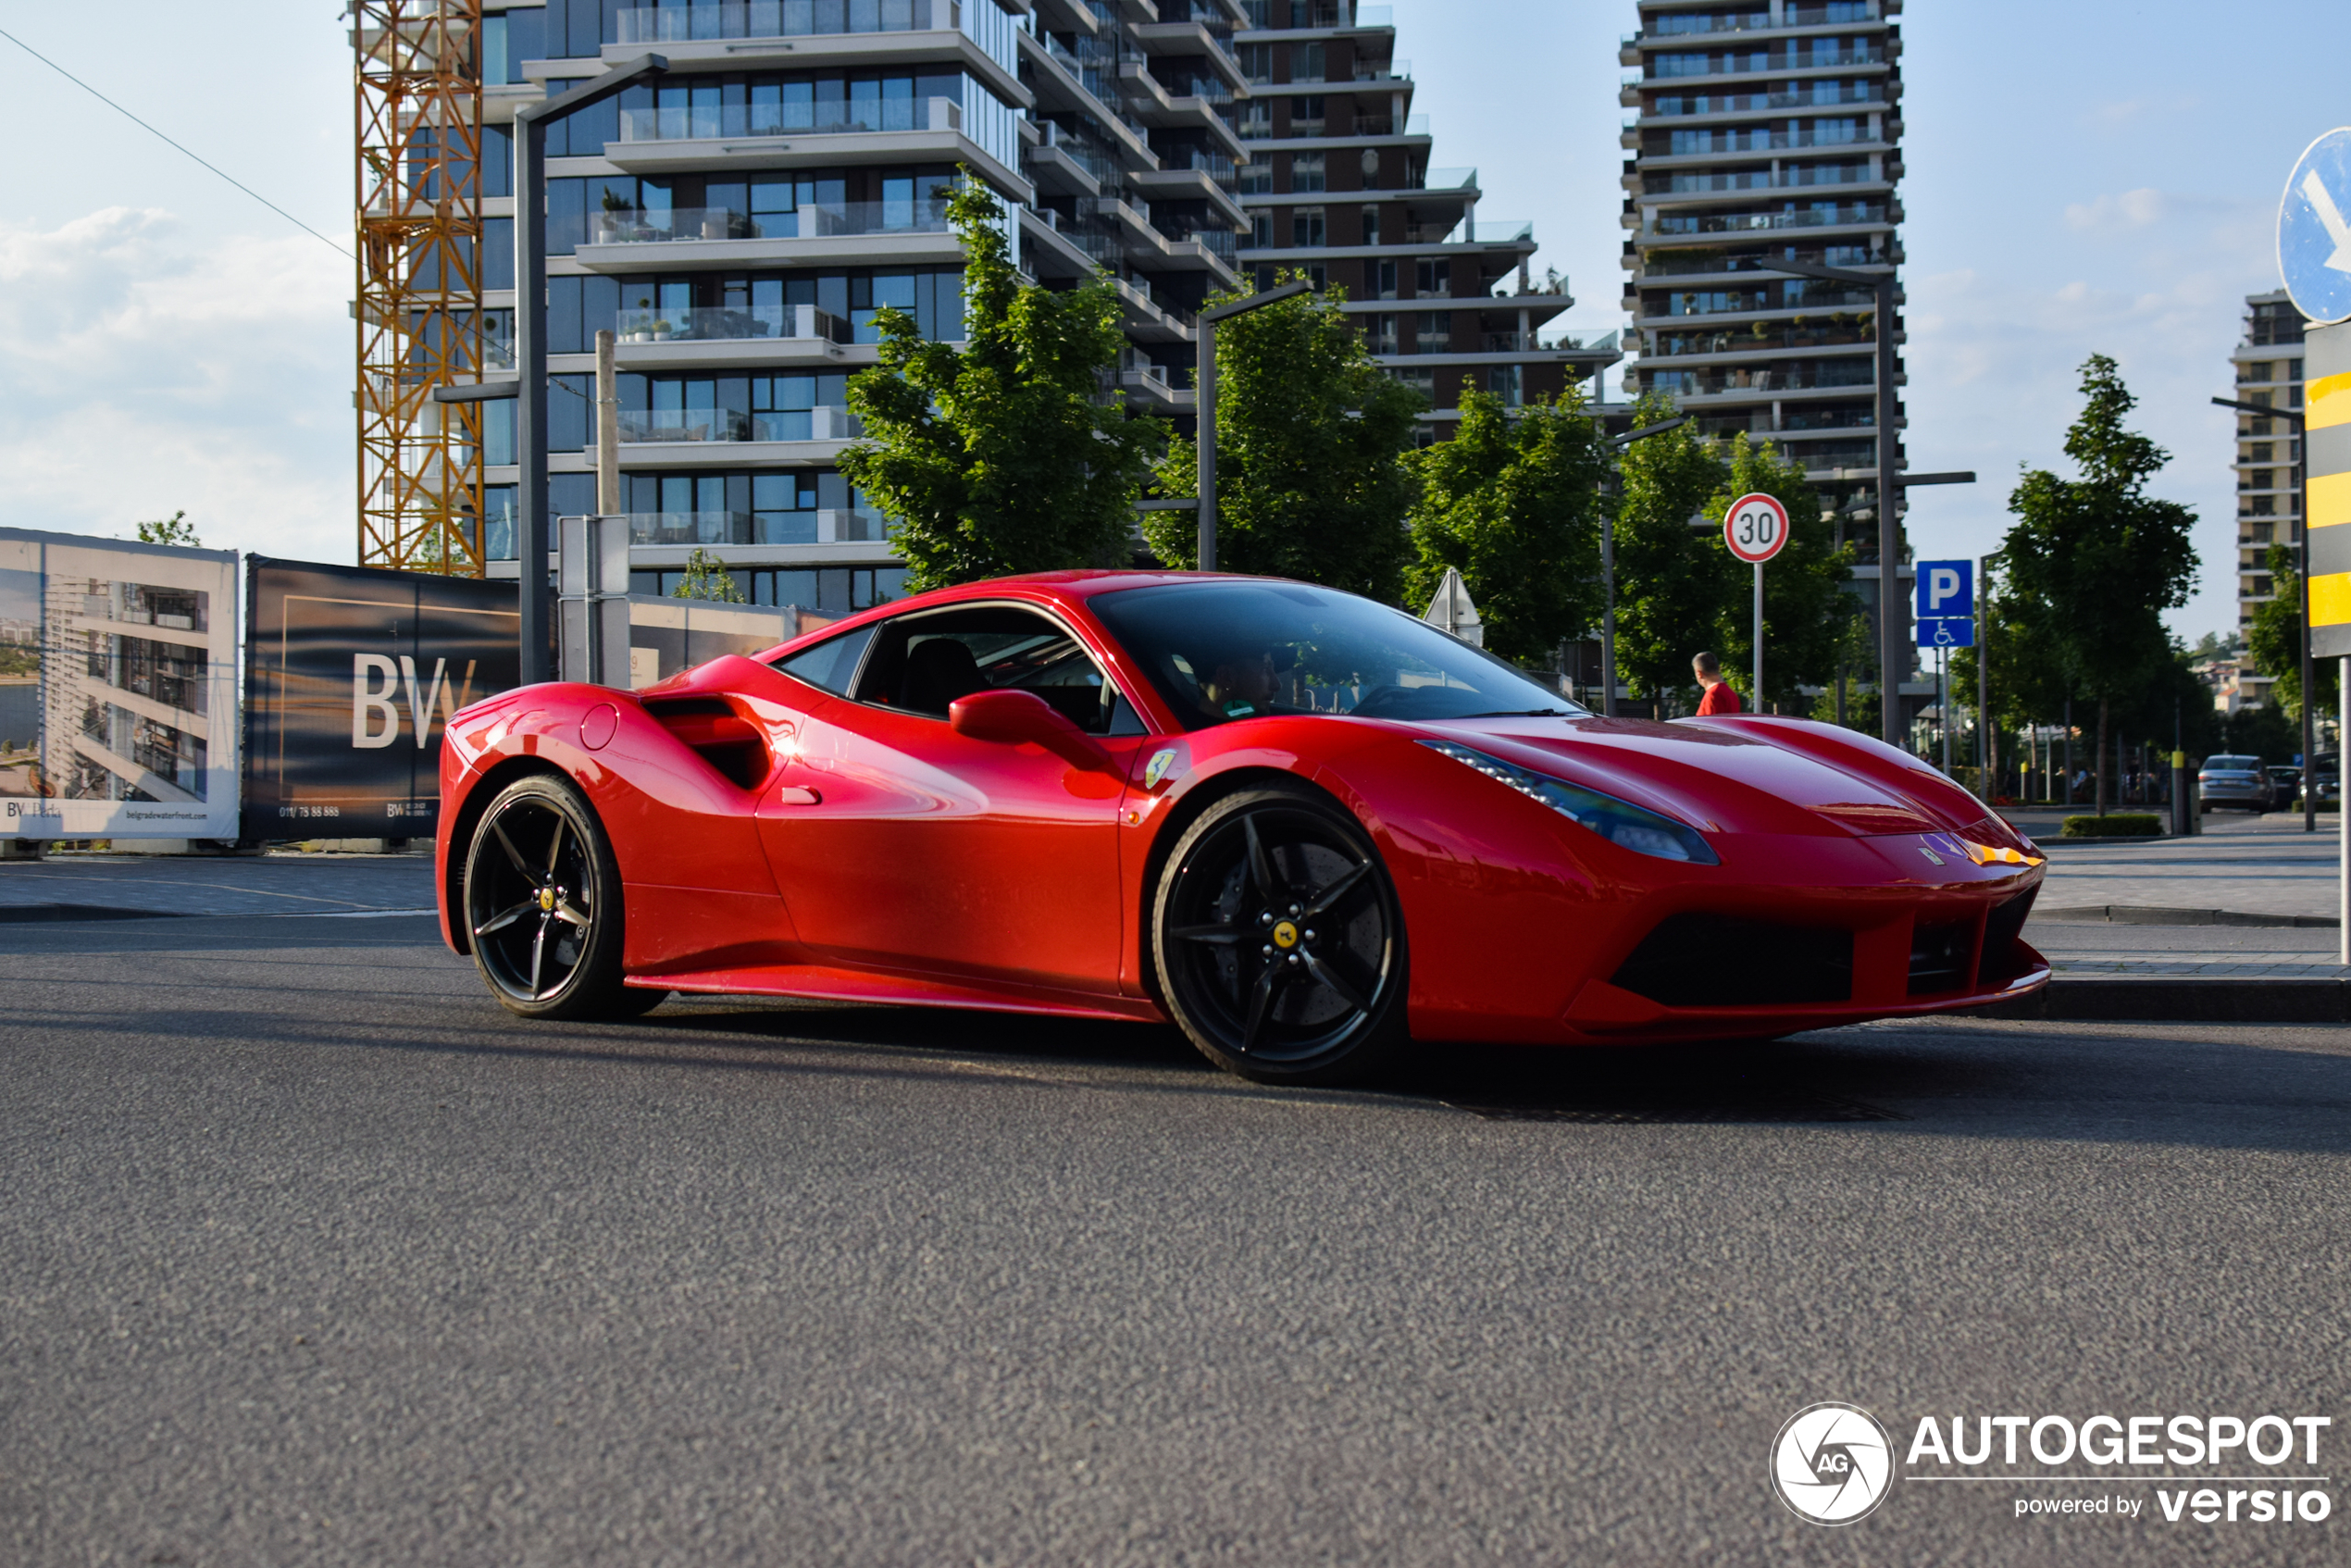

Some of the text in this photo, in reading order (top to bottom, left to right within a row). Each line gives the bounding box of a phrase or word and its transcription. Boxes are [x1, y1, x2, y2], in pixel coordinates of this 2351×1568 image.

[1739, 512, 1773, 545] 30
[1929, 567, 1960, 610] P
[126, 810, 207, 821] belgradewaterfront.com
